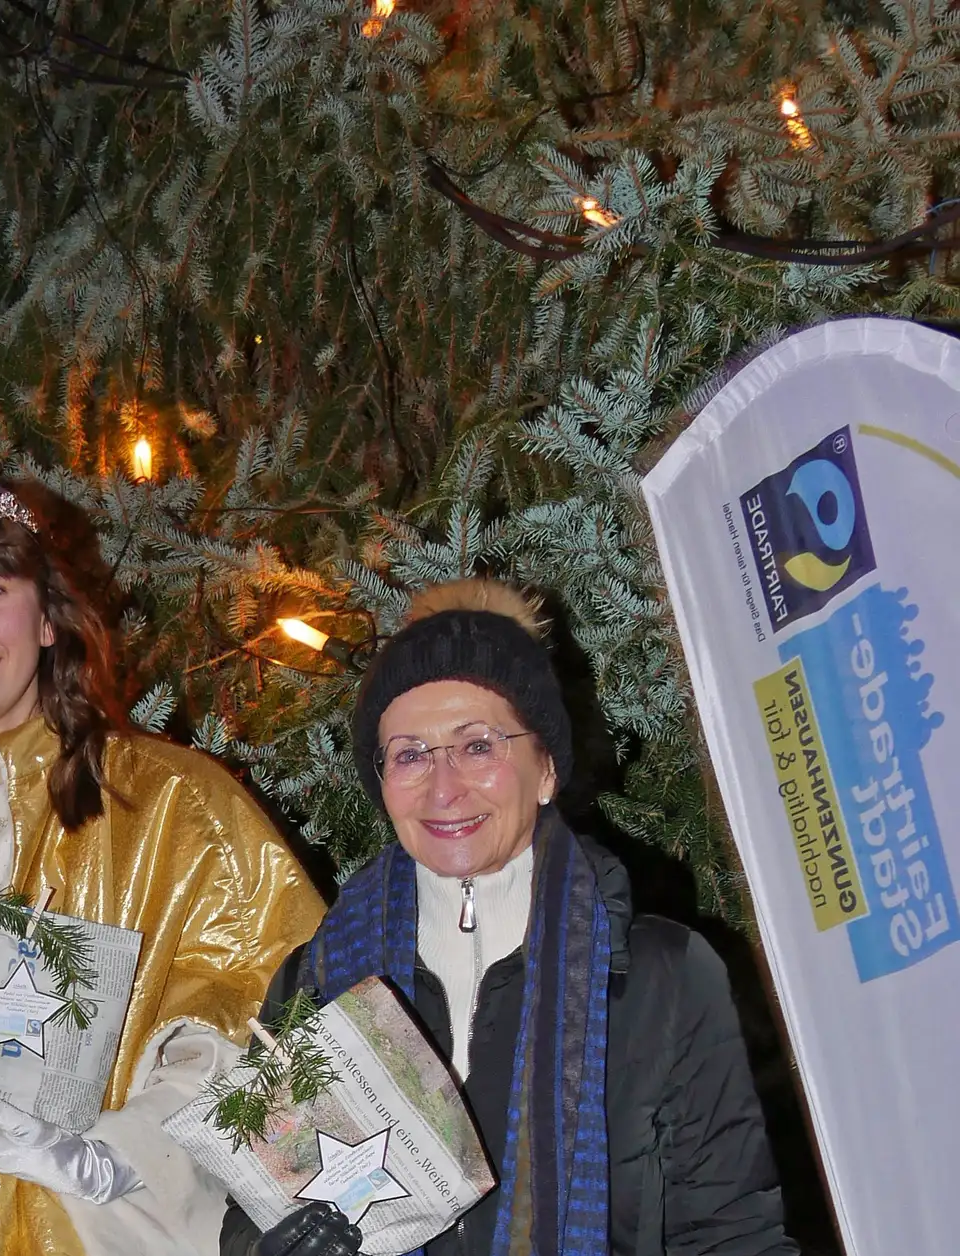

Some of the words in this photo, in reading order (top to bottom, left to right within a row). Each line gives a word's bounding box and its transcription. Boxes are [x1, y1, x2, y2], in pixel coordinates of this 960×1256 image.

[343, 1056, 378, 1105] Messen
[375, 1101, 400, 1131] und
[395, 1127, 420, 1156] eine
[446, 1195, 461, 1213] Fra
